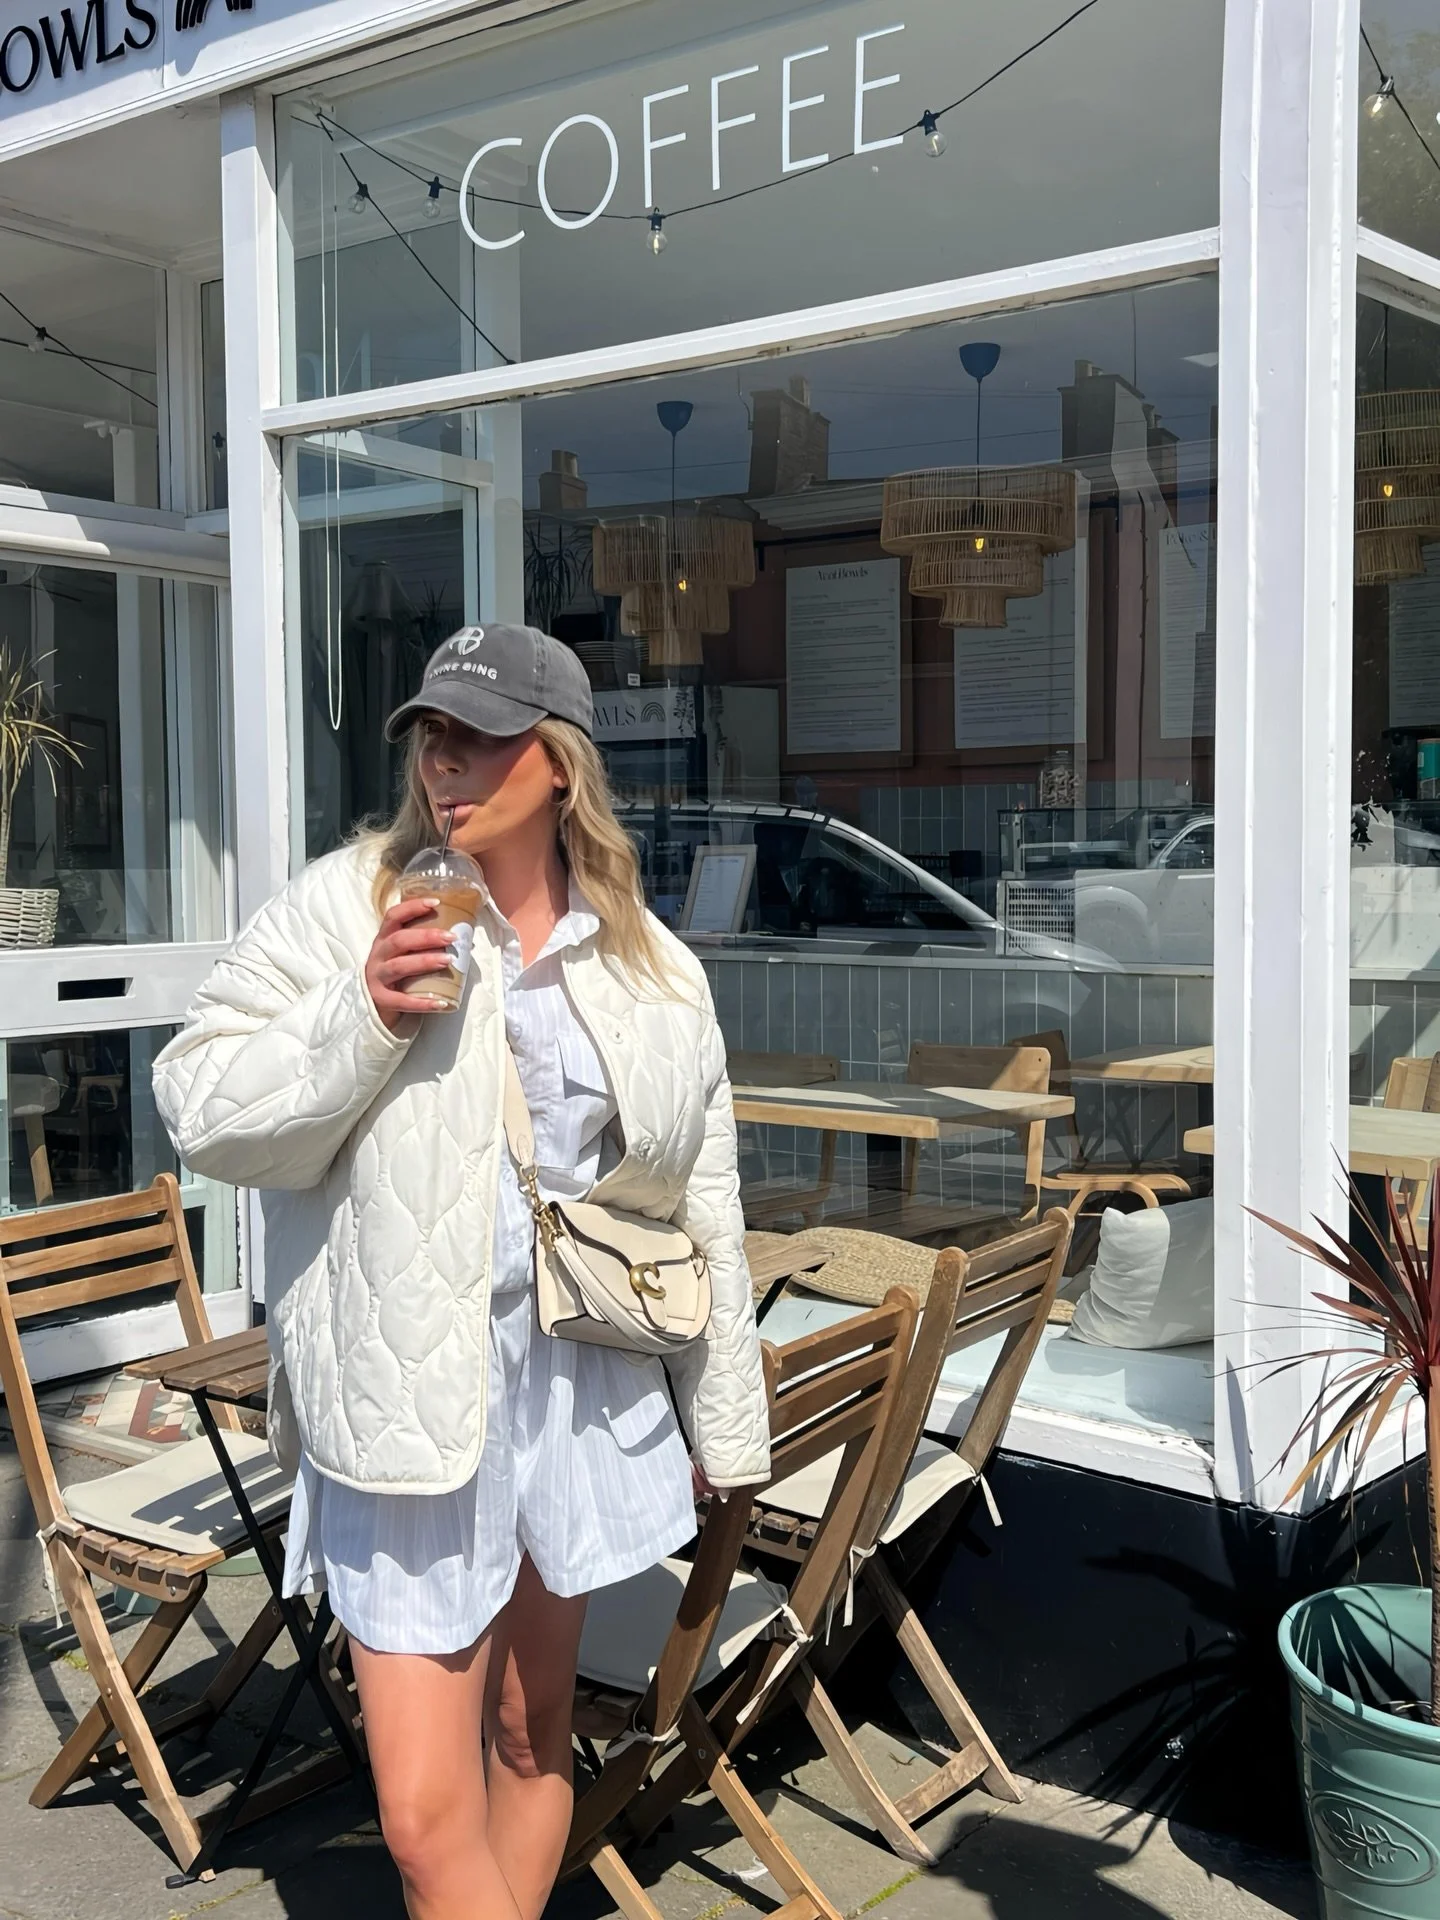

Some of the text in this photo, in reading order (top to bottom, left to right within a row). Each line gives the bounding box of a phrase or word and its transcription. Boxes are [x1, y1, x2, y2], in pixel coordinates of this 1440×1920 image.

[0, 0, 156, 92] OWLS
[459, 24, 905, 250] COFFEE
[462, 662, 498, 681] BING
[592, 704, 637, 728] WLS
